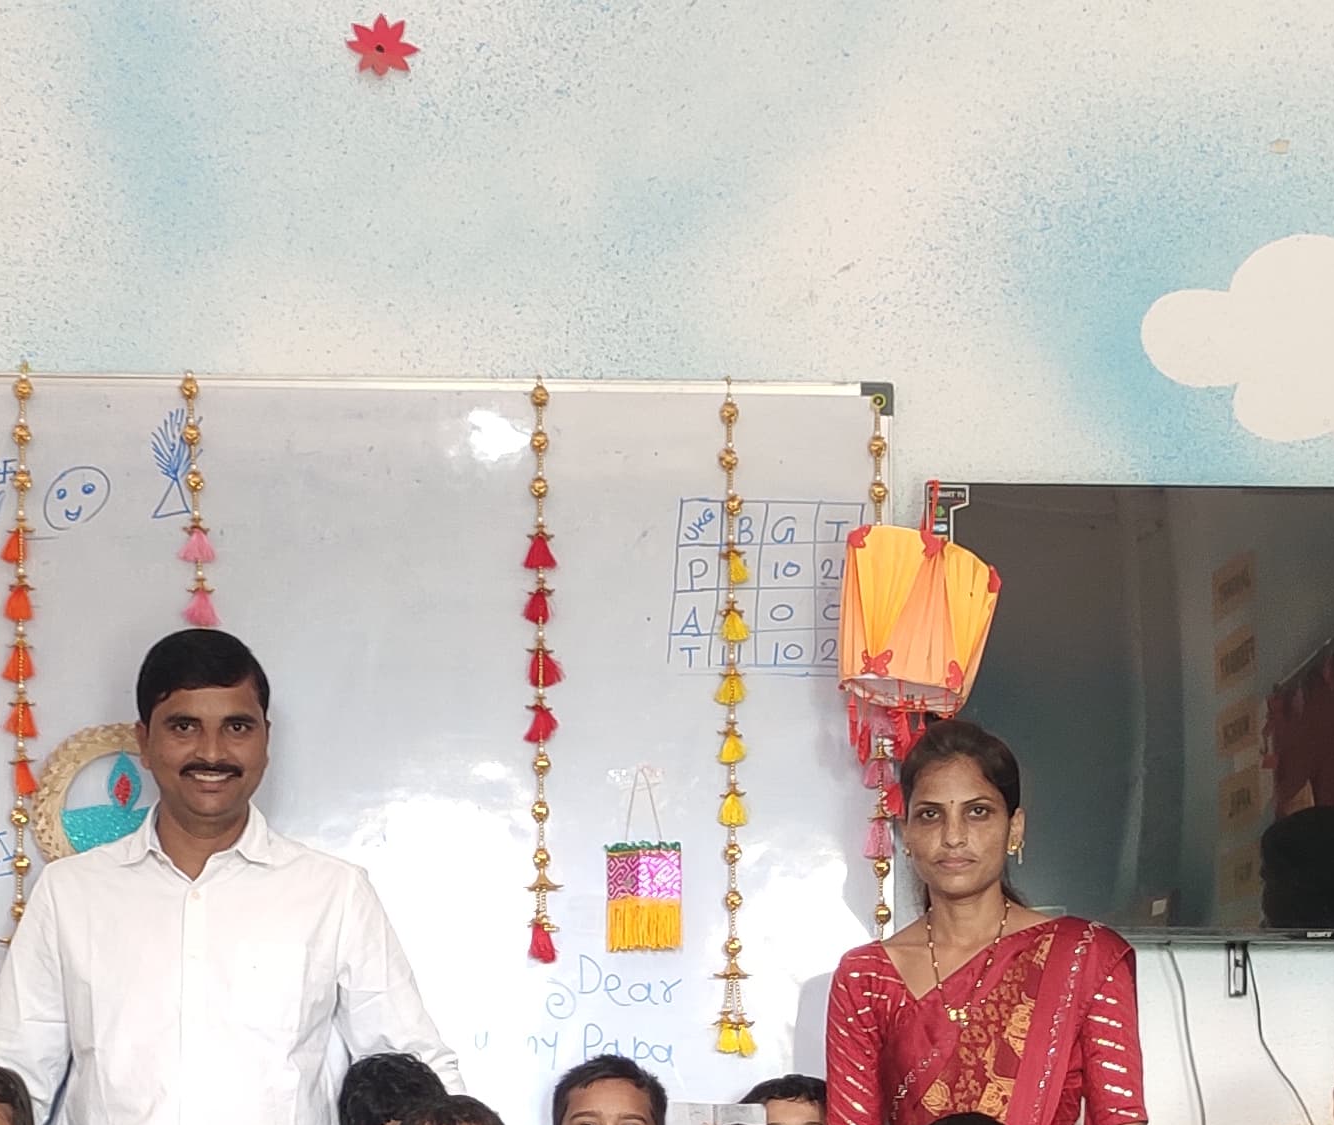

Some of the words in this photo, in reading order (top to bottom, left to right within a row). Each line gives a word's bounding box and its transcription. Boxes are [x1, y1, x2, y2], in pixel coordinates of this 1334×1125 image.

[738, 516, 754, 545] B
[771, 516, 797, 544] G
[825, 520, 849, 542] T
[689, 558, 709, 592] P
[773, 561, 801, 580] 10
[680, 606, 702, 636] A
[679, 646, 701, 668] T
[773, 642, 804, 667] 10
[821, 638, 839, 662] 2
[578, 954, 683, 1007] Dear
[583, 1023, 675, 1067] Papa
